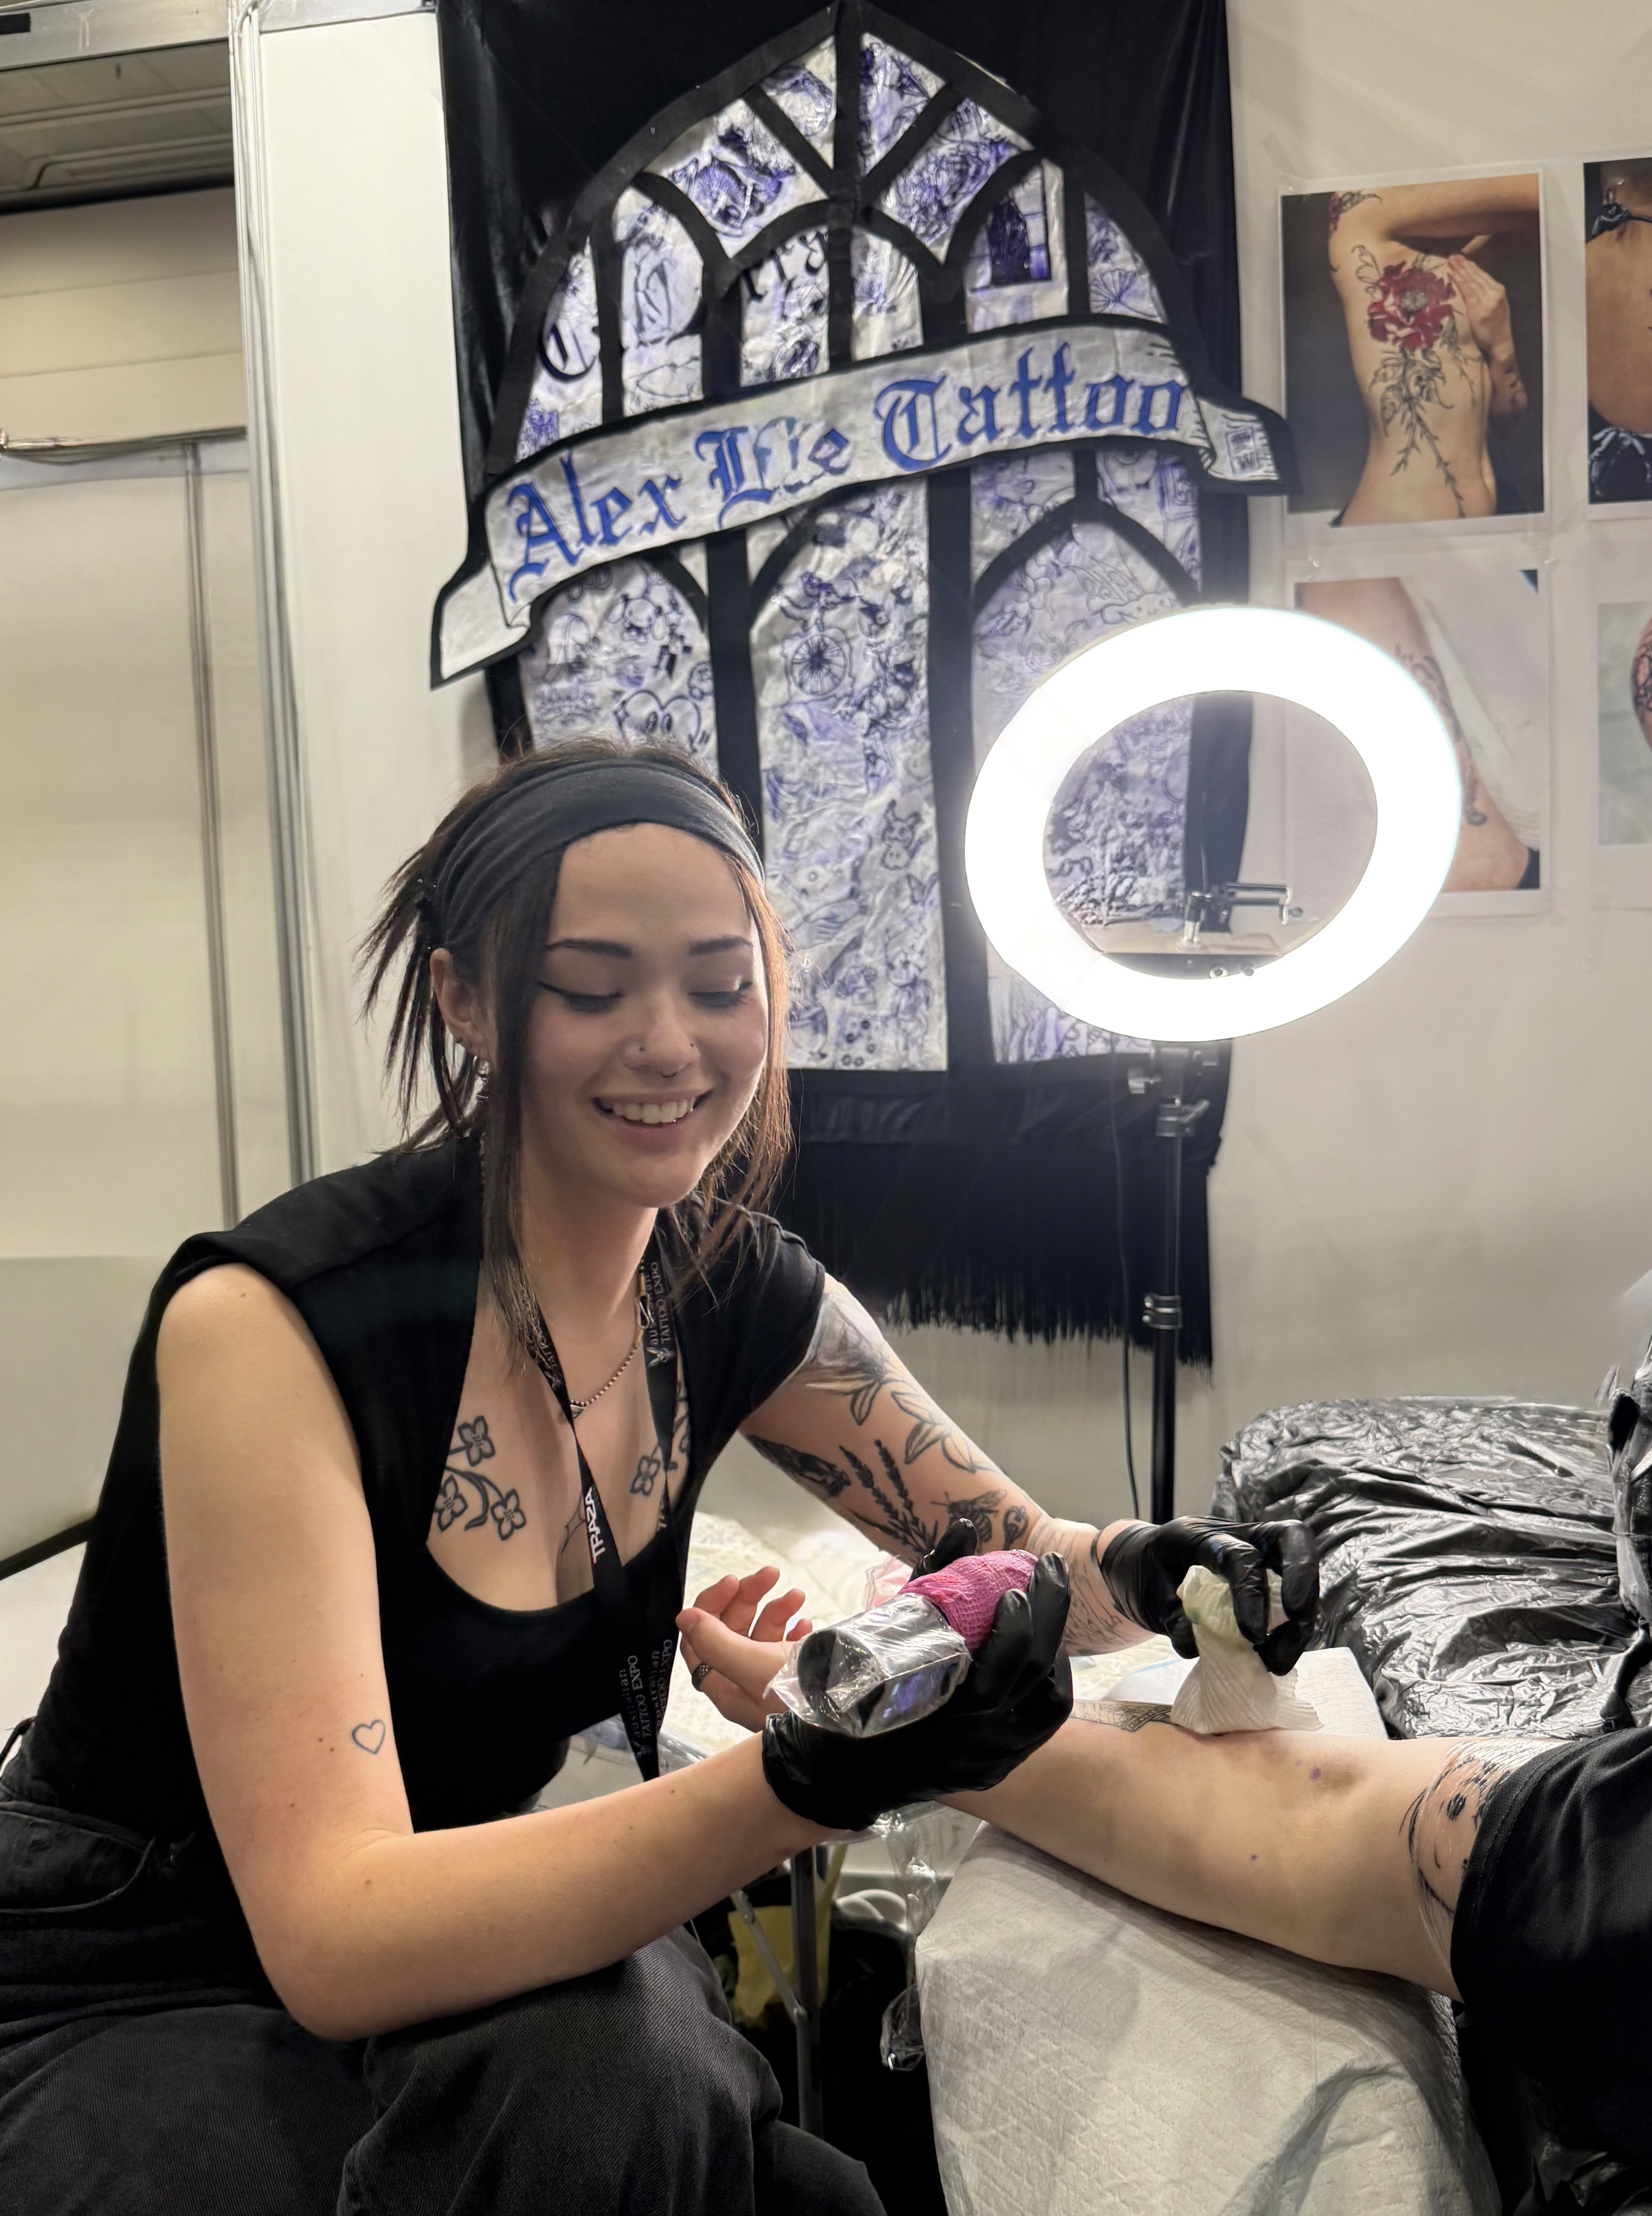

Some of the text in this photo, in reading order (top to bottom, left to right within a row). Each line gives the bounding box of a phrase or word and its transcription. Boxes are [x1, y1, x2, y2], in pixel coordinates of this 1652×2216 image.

[507, 450, 685, 604] Alex
[874, 342, 1187, 471] Tattoo
[650, 1261, 664, 1295] EXPO
[656, 1298, 670, 1343] TATTOO
[626, 1654, 652, 1739] TATTOO EXPO
